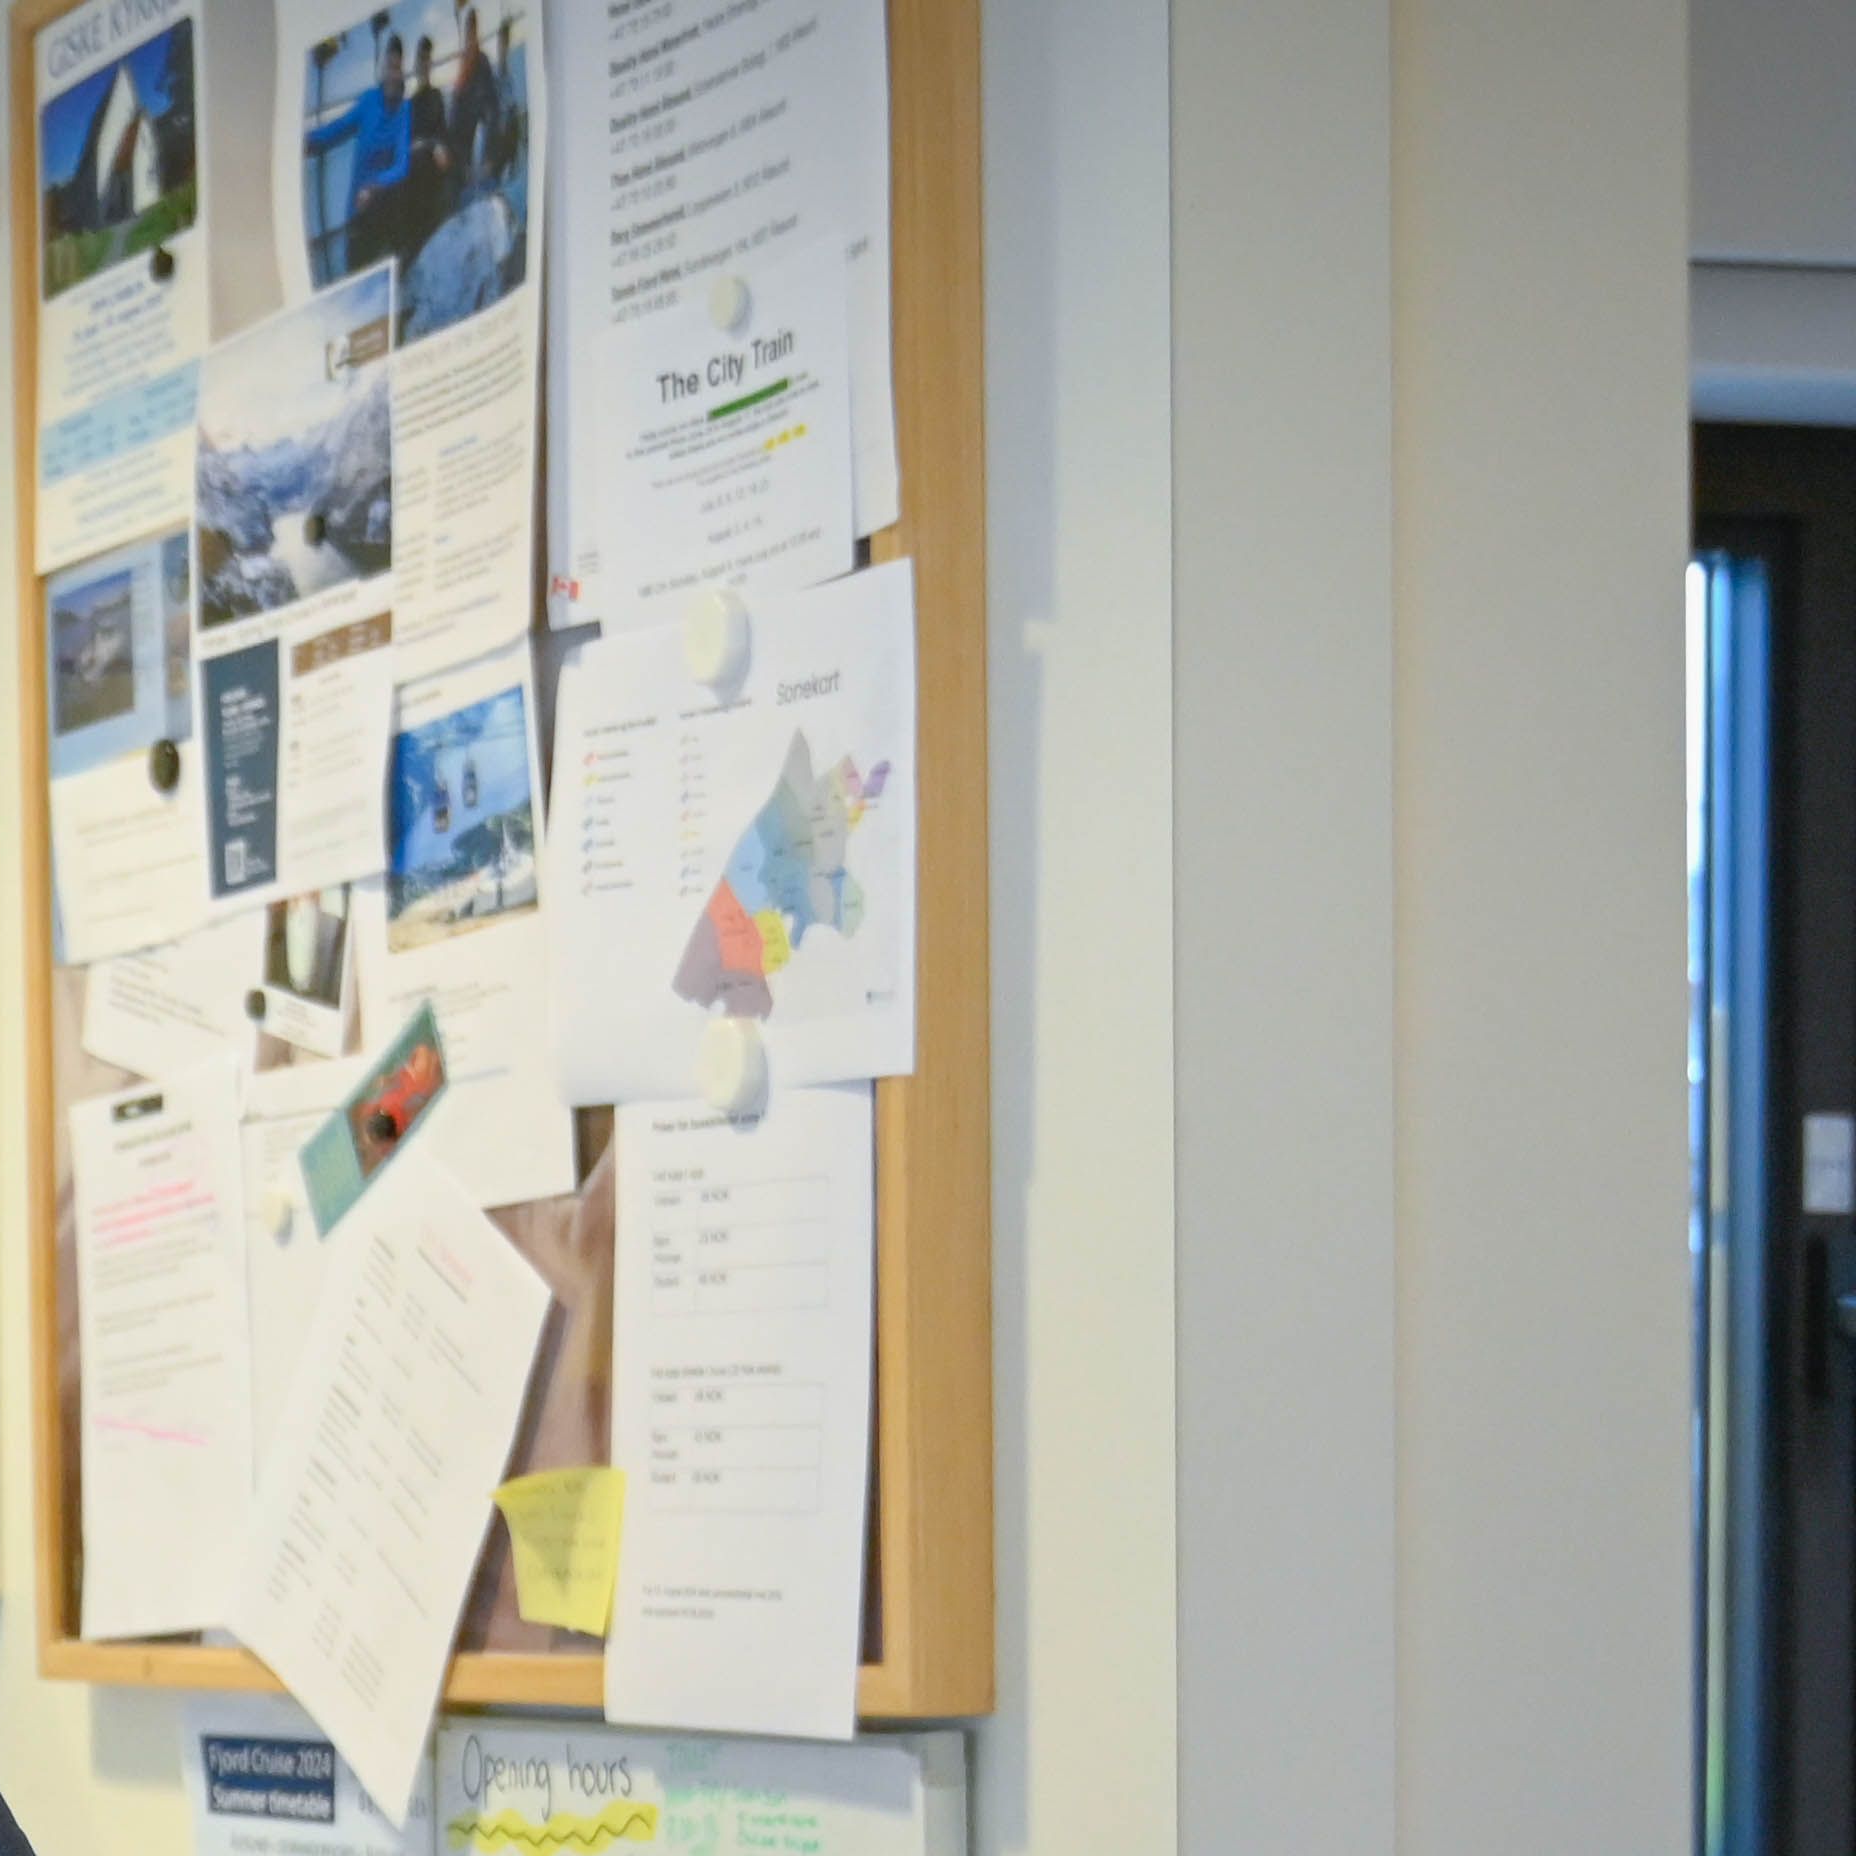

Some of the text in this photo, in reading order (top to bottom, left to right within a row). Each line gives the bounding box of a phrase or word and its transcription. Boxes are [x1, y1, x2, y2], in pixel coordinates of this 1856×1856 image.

[656, 327, 795, 404] The City Train
[775, 668, 841, 707] Sonekart
[209, 1742, 249, 1777] Fjord
[250, 1746, 294, 1777] Cruise
[462, 1735, 633, 1823] Opening hours
[212, 1784, 332, 1818] Summer timetable
